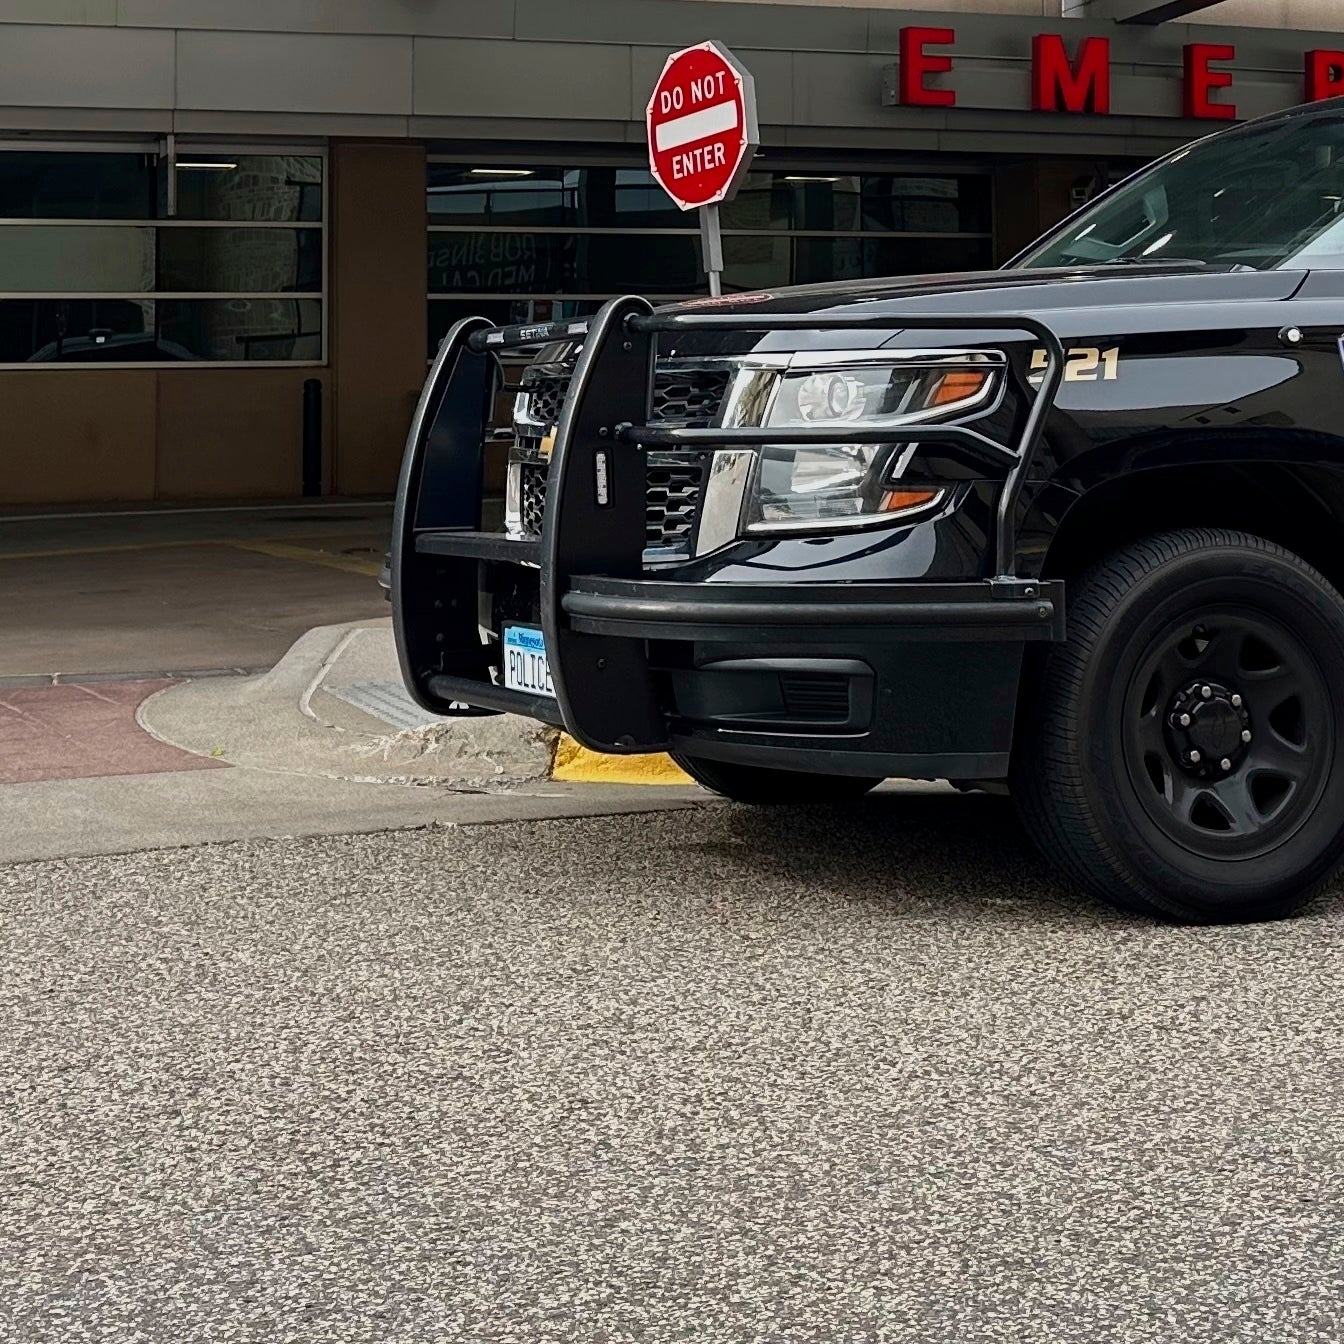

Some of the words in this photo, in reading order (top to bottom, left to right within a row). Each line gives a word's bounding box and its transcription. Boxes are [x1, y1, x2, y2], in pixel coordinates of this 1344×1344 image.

[660, 86, 684, 114] DO
[690, 70, 726, 104] NOT
[672, 142, 726, 180] ENTER
[509, 649, 553, 693] POLICE
